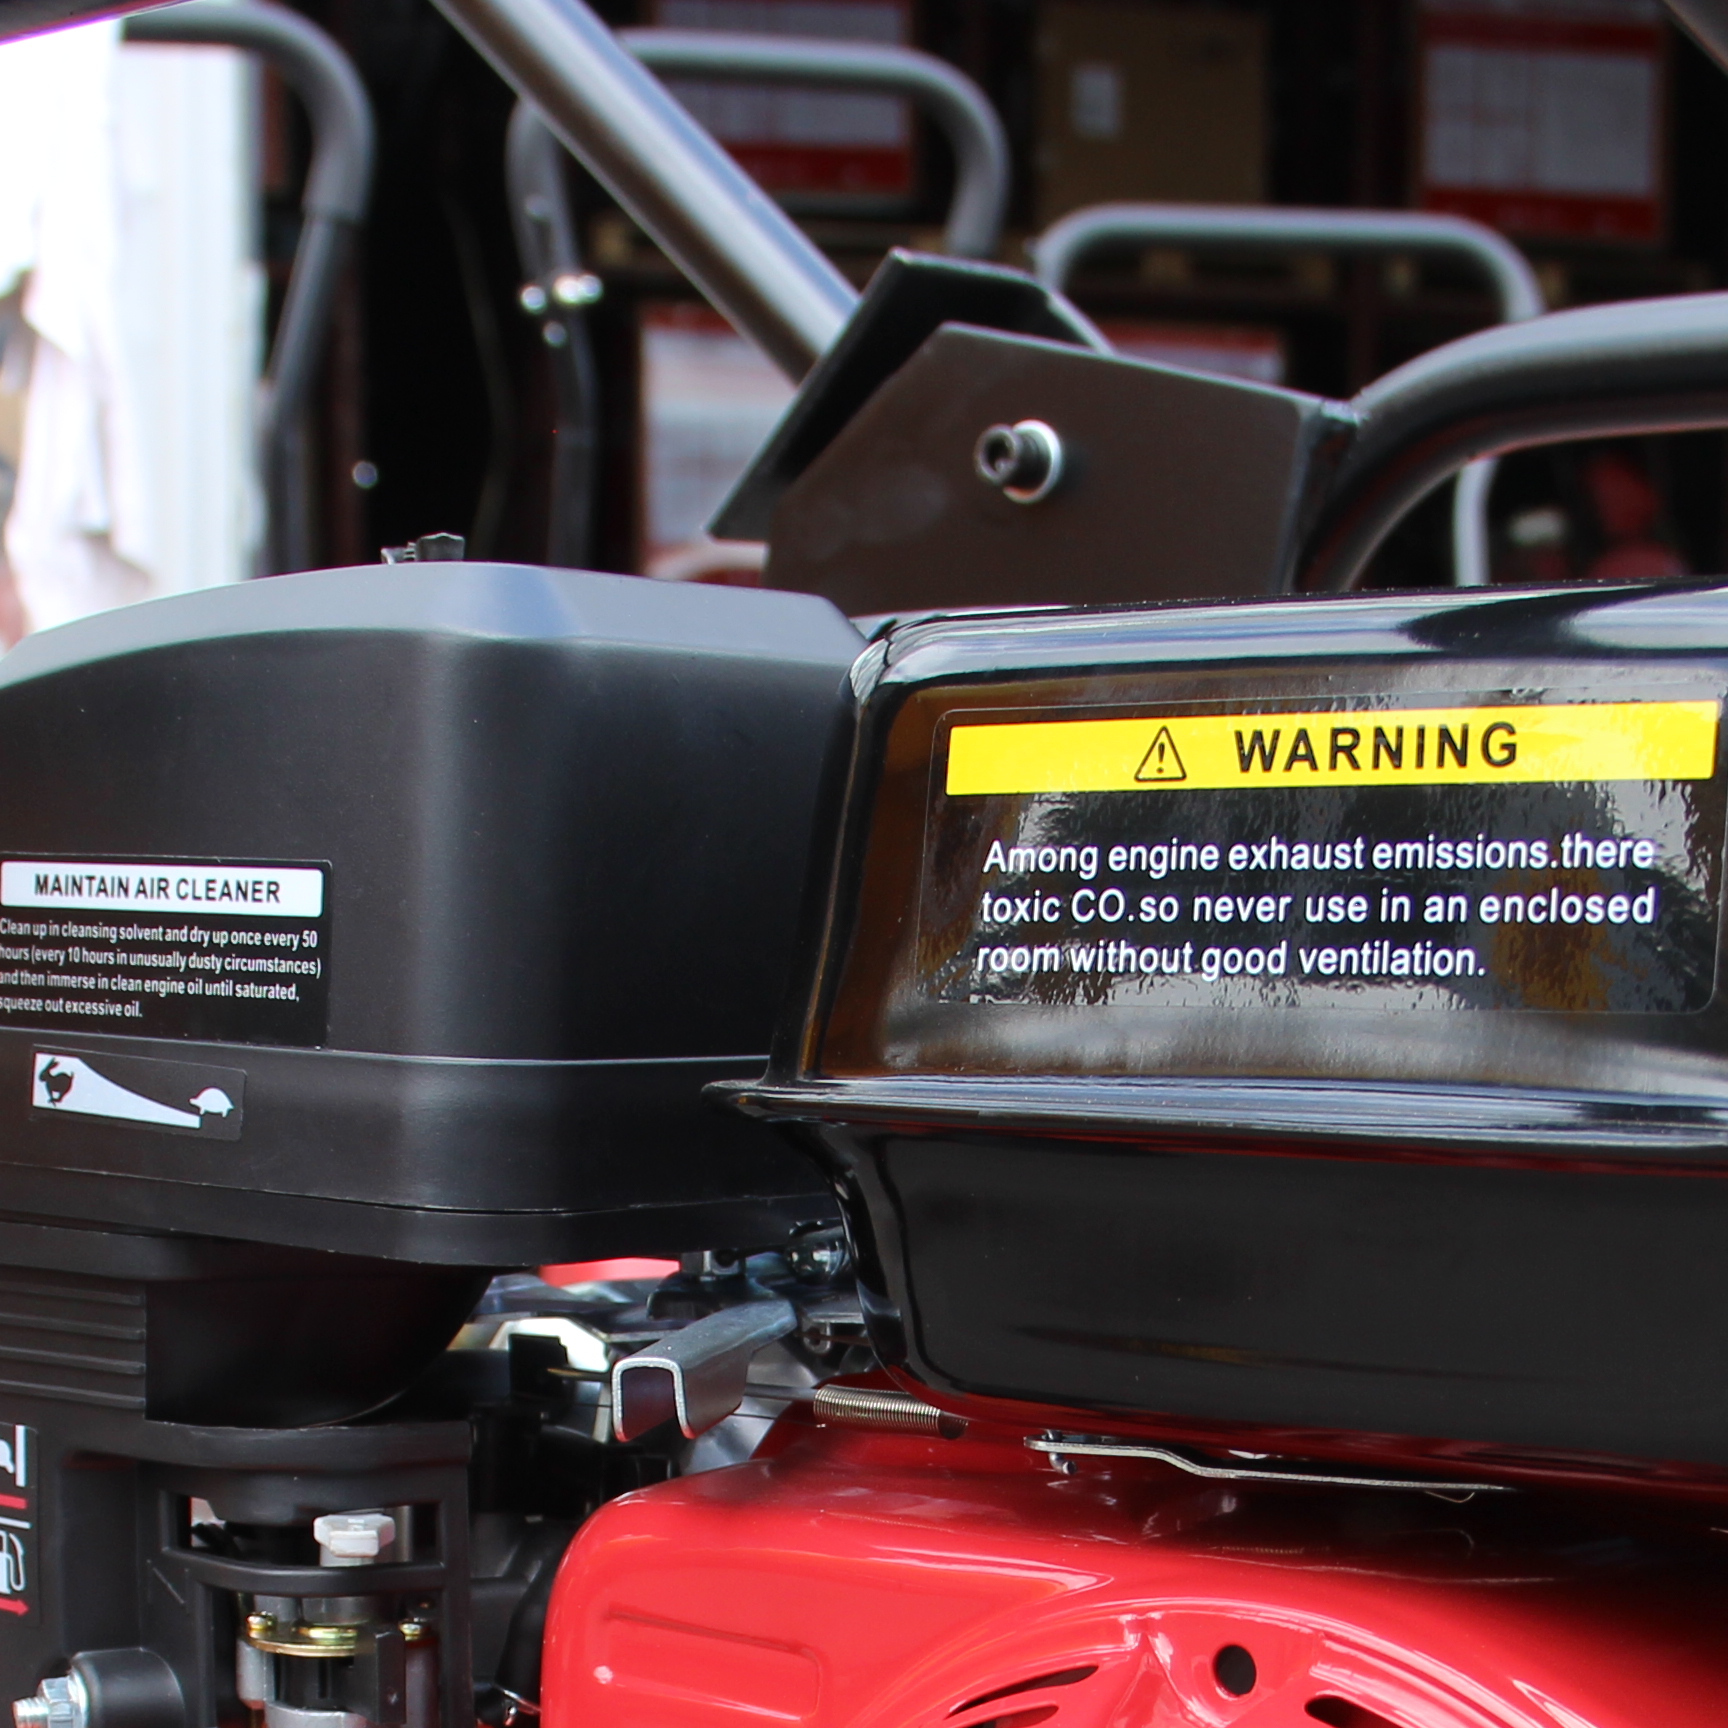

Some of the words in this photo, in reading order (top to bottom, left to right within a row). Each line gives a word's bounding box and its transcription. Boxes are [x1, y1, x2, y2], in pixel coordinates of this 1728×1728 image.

[1234, 722, 1518, 772] WARNING
[983, 839, 1098, 879] Among
[1108, 839, 1219, 878] engine
[1228, 836, 1364, 869] exhaust
[35, 874, 129, 897] MAINTAIN
[135, 877, 169, 898] AIR
[176, 878, 279, 902] CLEANER
[981, 890, 1061, 923] toxic
[1192, 896, 1292, 922] never
[1305, 896, 1367, 922] use
[1380, 888, 1410, 922] in
[1423, 896, 1467, 922] an
[1479, 886, 1655, 923] enclosed
[0, 918, 30, 934] Clean
[32, 924, 47, 938] up
[48, 920, 59, 935] in
[61, 921, 117, 942] cleansing
[118, 924, 163, 940] solvent
[164, 925, 188, 941] and
[189, 926, 210, 947] dry
[212, 931, 228, 946] up
[230, 931, 262, 944] once
[263, 933, 300, 950] every
[301, 930, 318, 947] 50
[31, 946, 65, 965] (every
[67, 947, 80, 962] 10
[82, 947, 115, 964] hours
[116, 949, 127, 964] in
[128, 951, 187, 971] unusually
[188, 952, 223, 973] dusty
[224, 954, 321, 978] circumstances)
[976, 946, 1060, 974] room
[1069, 940, 1193, 974] without
[1200, 940, 1288, 982] good
[1297, 940, 1487, 977] ventilation.
[19, 970, 44, 985] then
[46, 971, 96, 988] immerse
[97, 973, 108, 988] in
[110, 974, 142, 990] clean
[143, 976, 185, 996] engine
[186, 977, 203, 994] oil
[204, 979, 233, 995] until
[44, 998, 64, 1012] out
[64, 999, 122, 1015] excessive
[123, 1000, 142, 1016] oil.
